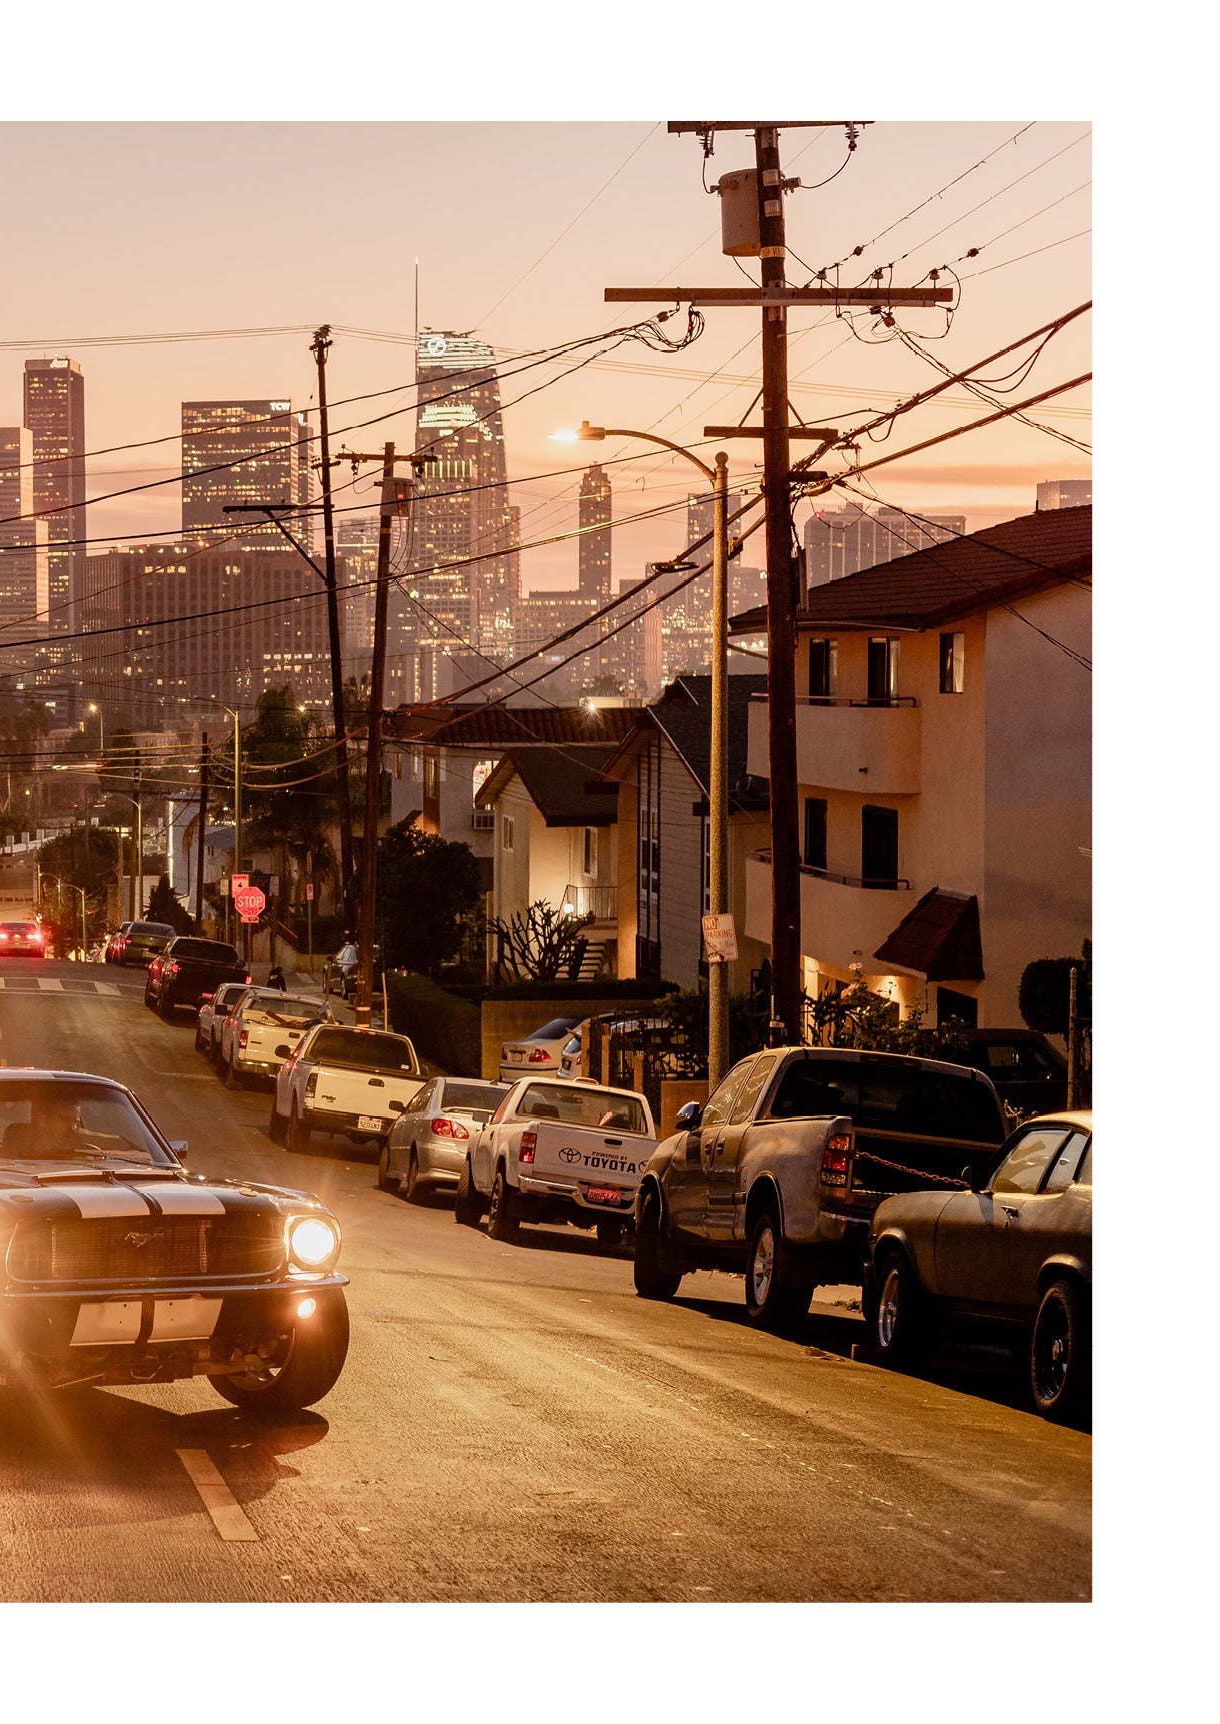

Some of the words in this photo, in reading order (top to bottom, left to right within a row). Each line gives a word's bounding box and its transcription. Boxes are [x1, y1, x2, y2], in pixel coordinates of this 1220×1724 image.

[237, 895, 263, 908] STOP
[704, 918, 717, 930] NO
[705, 929, 733, 939] PARKING
[591, 1151, 619, 1160] POWERED
[583, 1155, 636, 1174] TOYOTA
